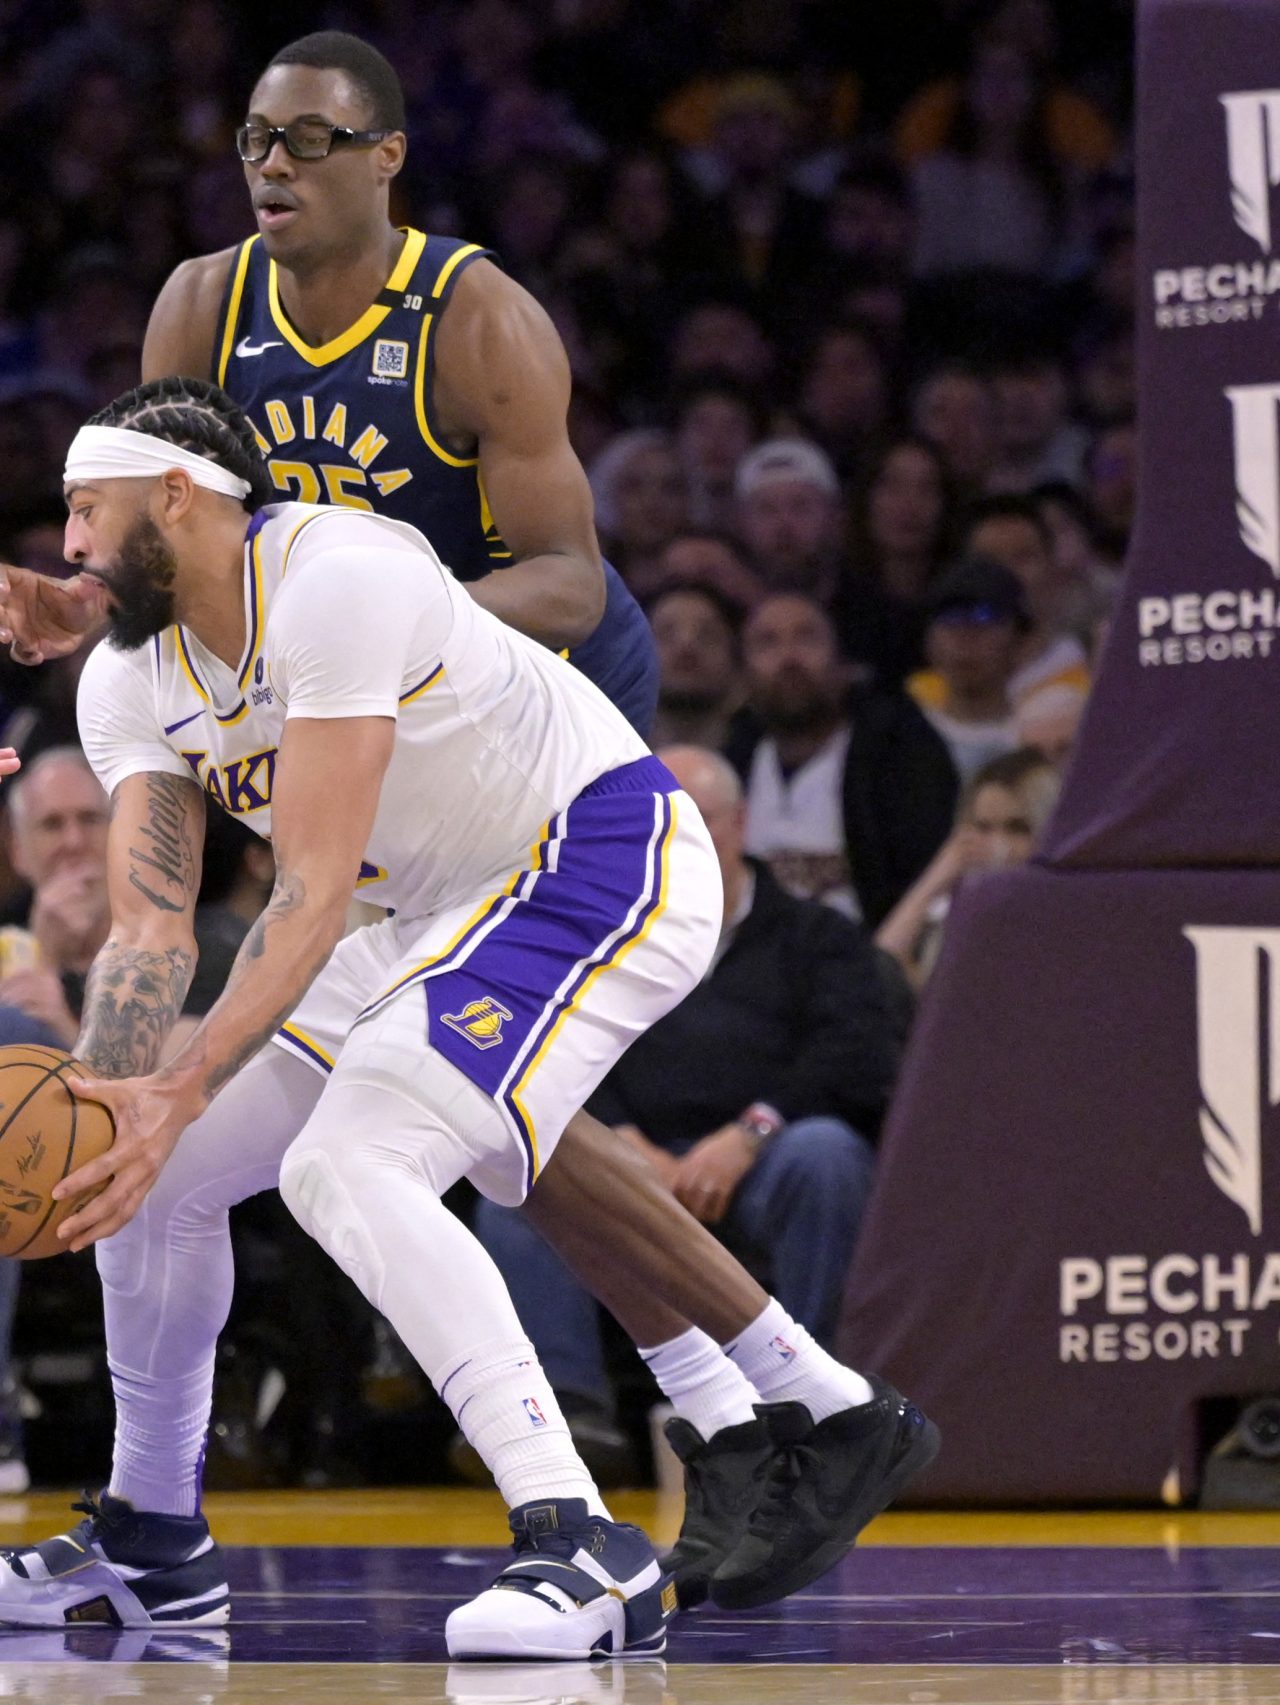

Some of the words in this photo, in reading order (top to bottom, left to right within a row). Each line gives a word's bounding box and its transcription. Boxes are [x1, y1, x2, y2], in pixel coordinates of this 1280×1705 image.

[403, 294, 423, 311] 30
[1154, 298, 1265, 329] RESORT
[1139, 588, 1280, 638] PECH
[1139, 630, 1275, 667] RESORT
[1059, 1319, 1252, 1364] RESORT
